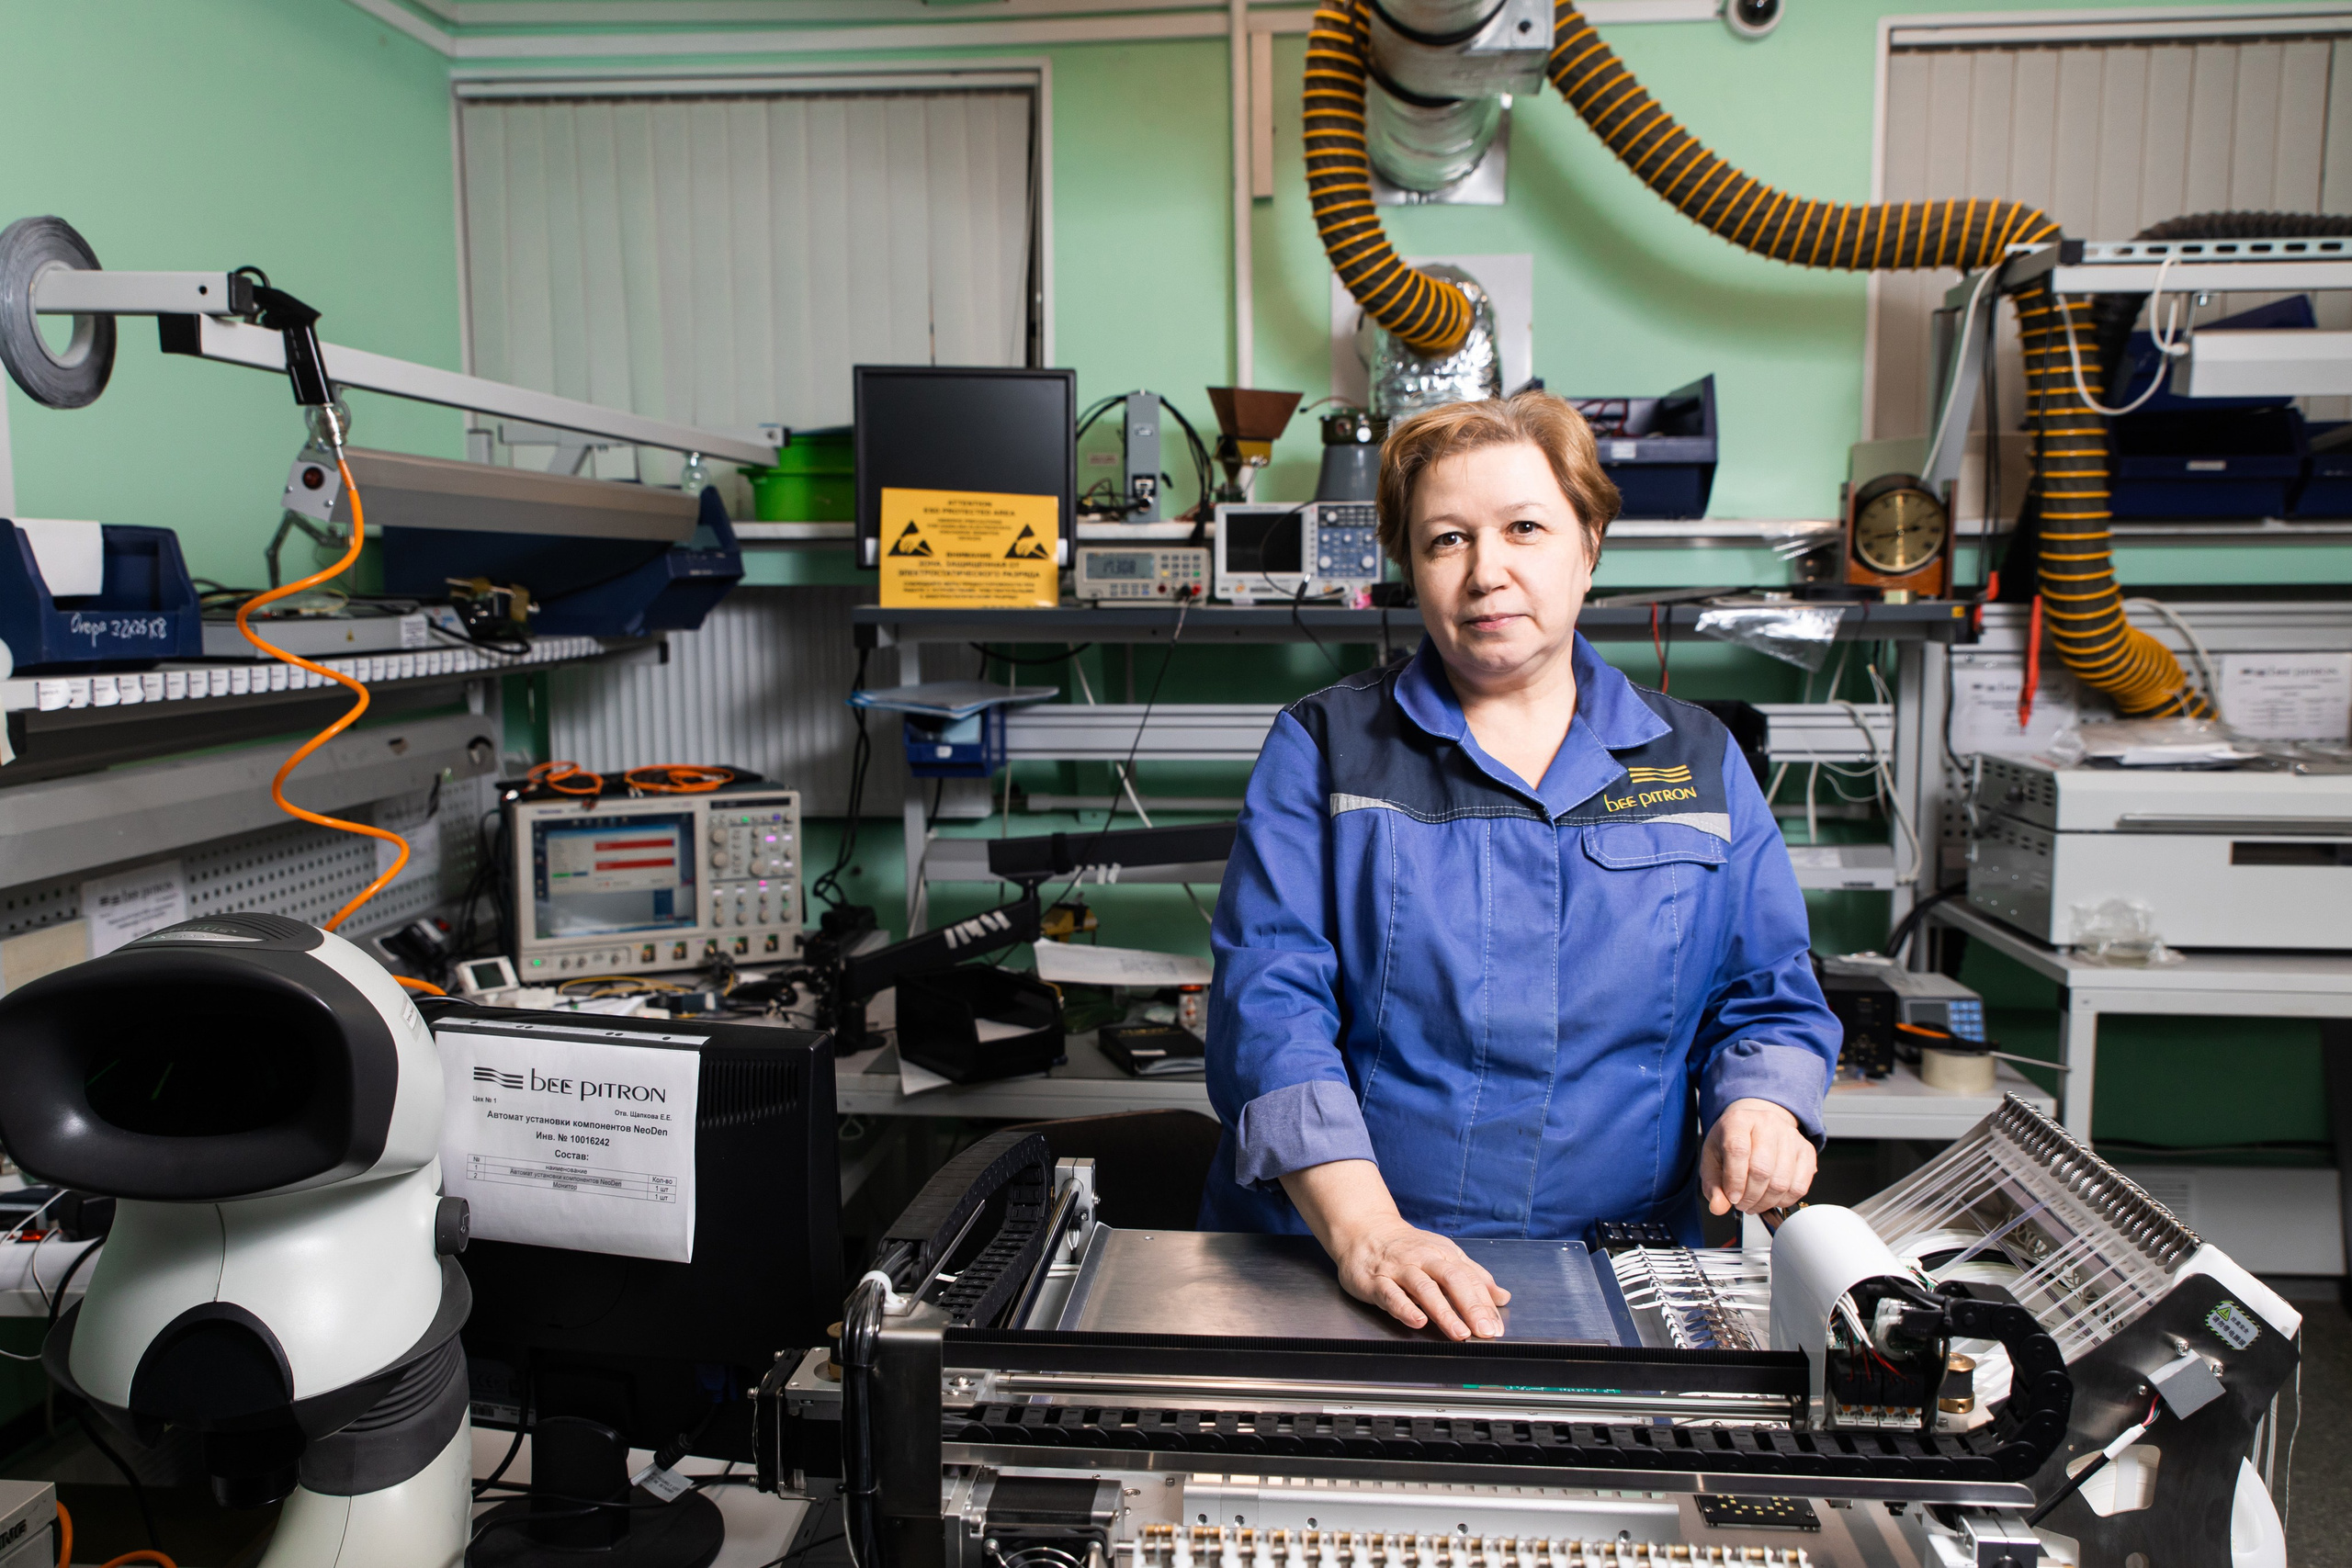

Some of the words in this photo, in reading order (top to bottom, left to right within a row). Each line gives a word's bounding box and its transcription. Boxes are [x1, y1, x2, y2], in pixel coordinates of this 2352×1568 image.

[630, 1111, 659, 1120] Щапкова
[487, 1110, 524, 1122] Автомат
[526, 1115, 571, 1126] установки
[572, 1121, 631, 1133] компонентов
[633, 1125, 668, 1136] NeoDen
[536, 1131, 556, 1141] Инв.
[558, 1134, 568, 1142] №
[570, 1134, 610, 1146] 10016242
[555, 1149, 589, 1161] Состав:
[510, 1168, 533, 1177] Автомат
[534, 1172, 562, 1180] установки
[562, 1176, 599, 1184] компонентов
[600, 1179, 622, 1187] NeoDen
[651, 1176, 673, 1185] Кол-во
[552, 1181, 578, 1190] Монитор
